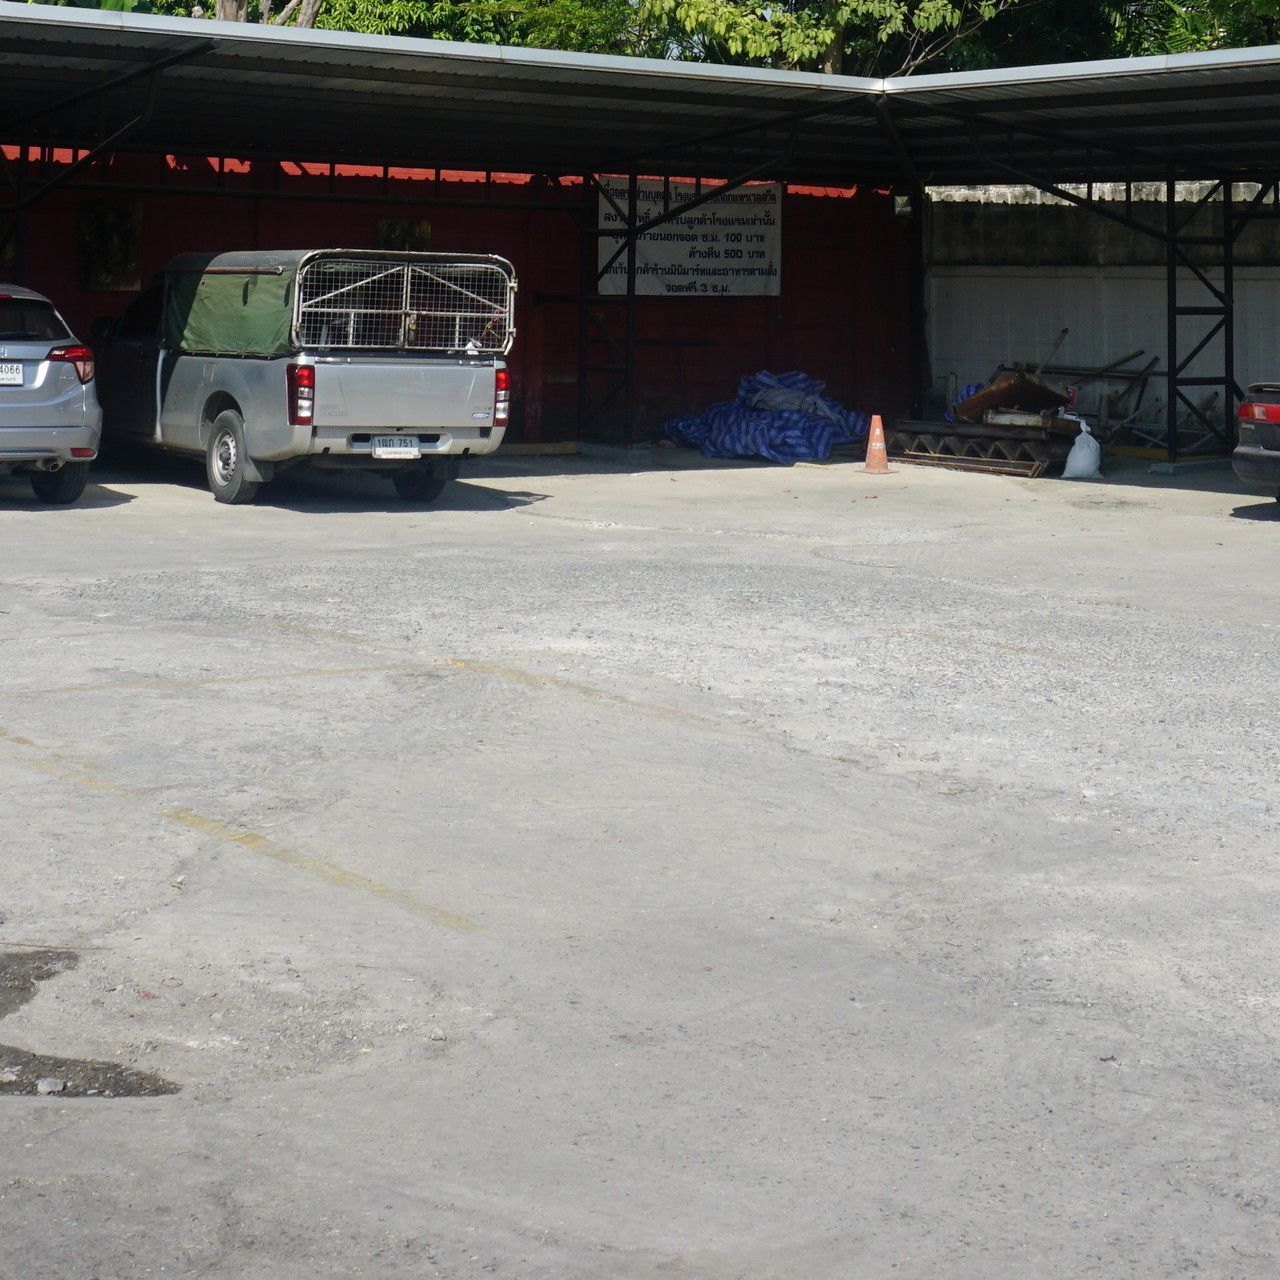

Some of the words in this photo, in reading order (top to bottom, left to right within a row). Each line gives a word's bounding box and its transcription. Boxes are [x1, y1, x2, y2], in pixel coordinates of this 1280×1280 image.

[724, 233, 743, 242] 100
[745, 233, 765, 243] บาท
[688, 246, 720, 259] ค้างคืน
[724, 249, 743, 259] 500
[747, 250, 766, 259] บาท
[665, 281, 697, 293] จอดฟรี
[700, 283, 708, 293] 3
[0, 365, 21, 374] 4066
[398, 438, 413, 448] 751
